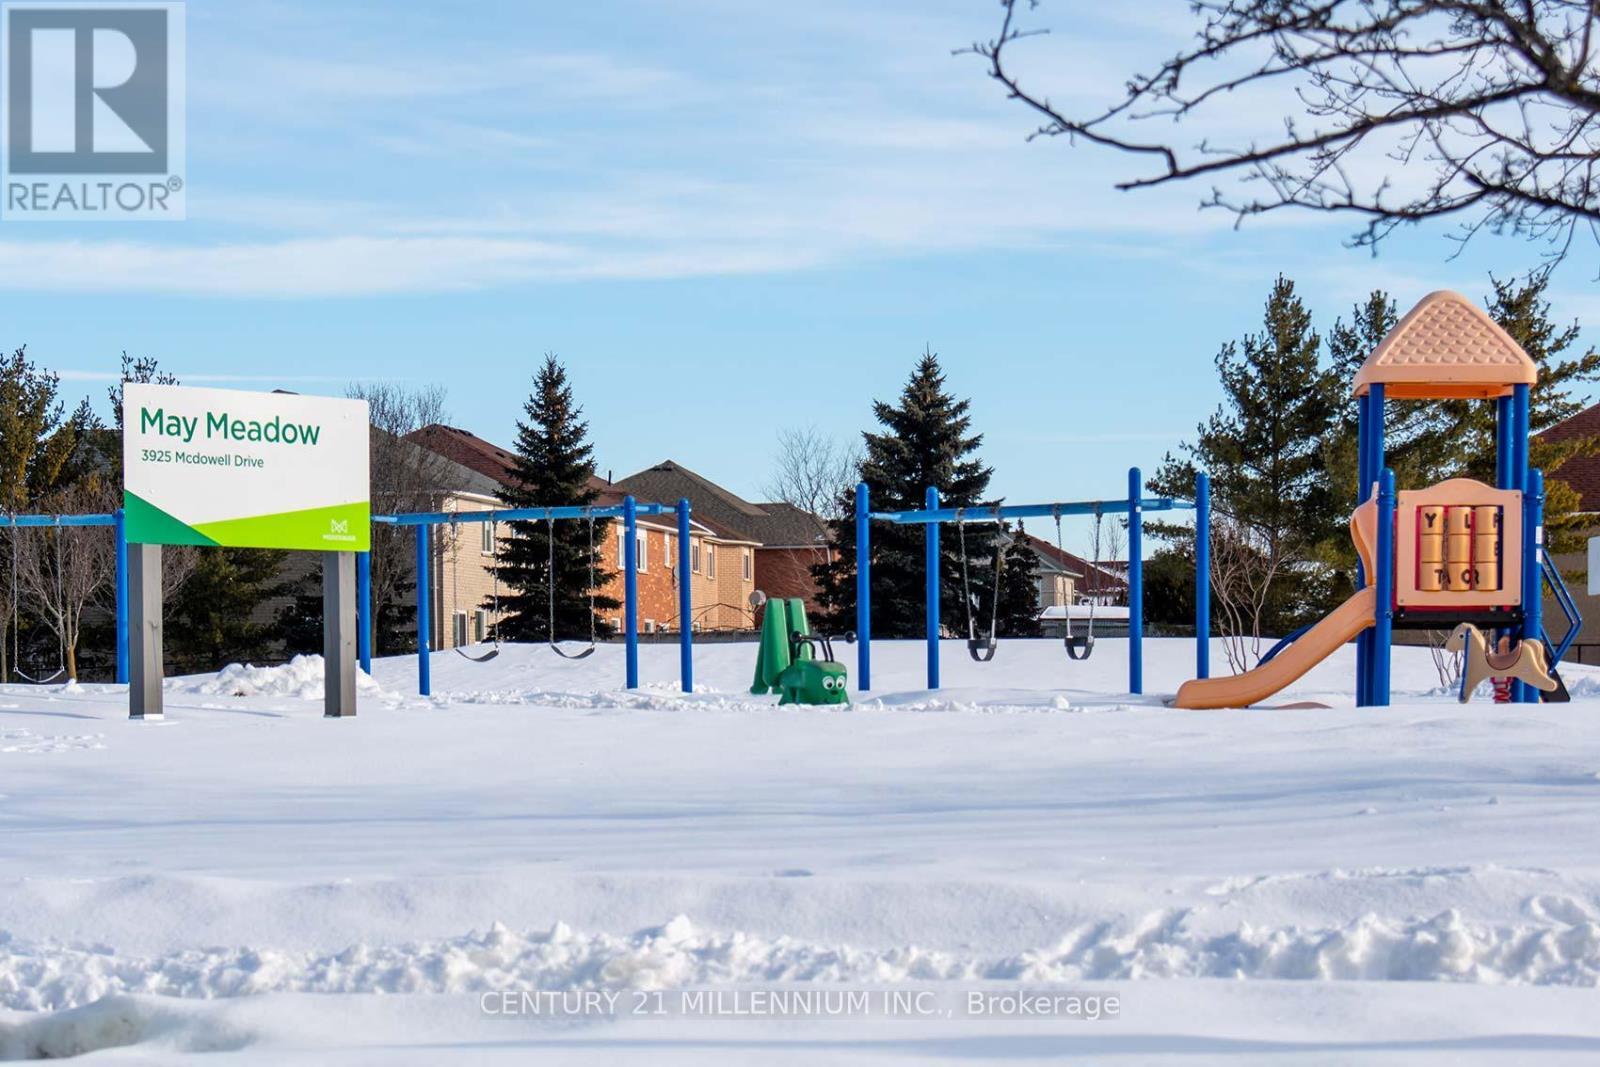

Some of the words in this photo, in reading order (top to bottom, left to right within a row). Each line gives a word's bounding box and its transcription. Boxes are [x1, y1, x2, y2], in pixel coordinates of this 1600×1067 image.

[140, 407, 198, 443] May
[206, 411, 321, 446] Meadow
[141, 449, 172, 463] 3925
[175, 451, 231, 467] Mcdowell
[234, 454, 265, 468] Drive
